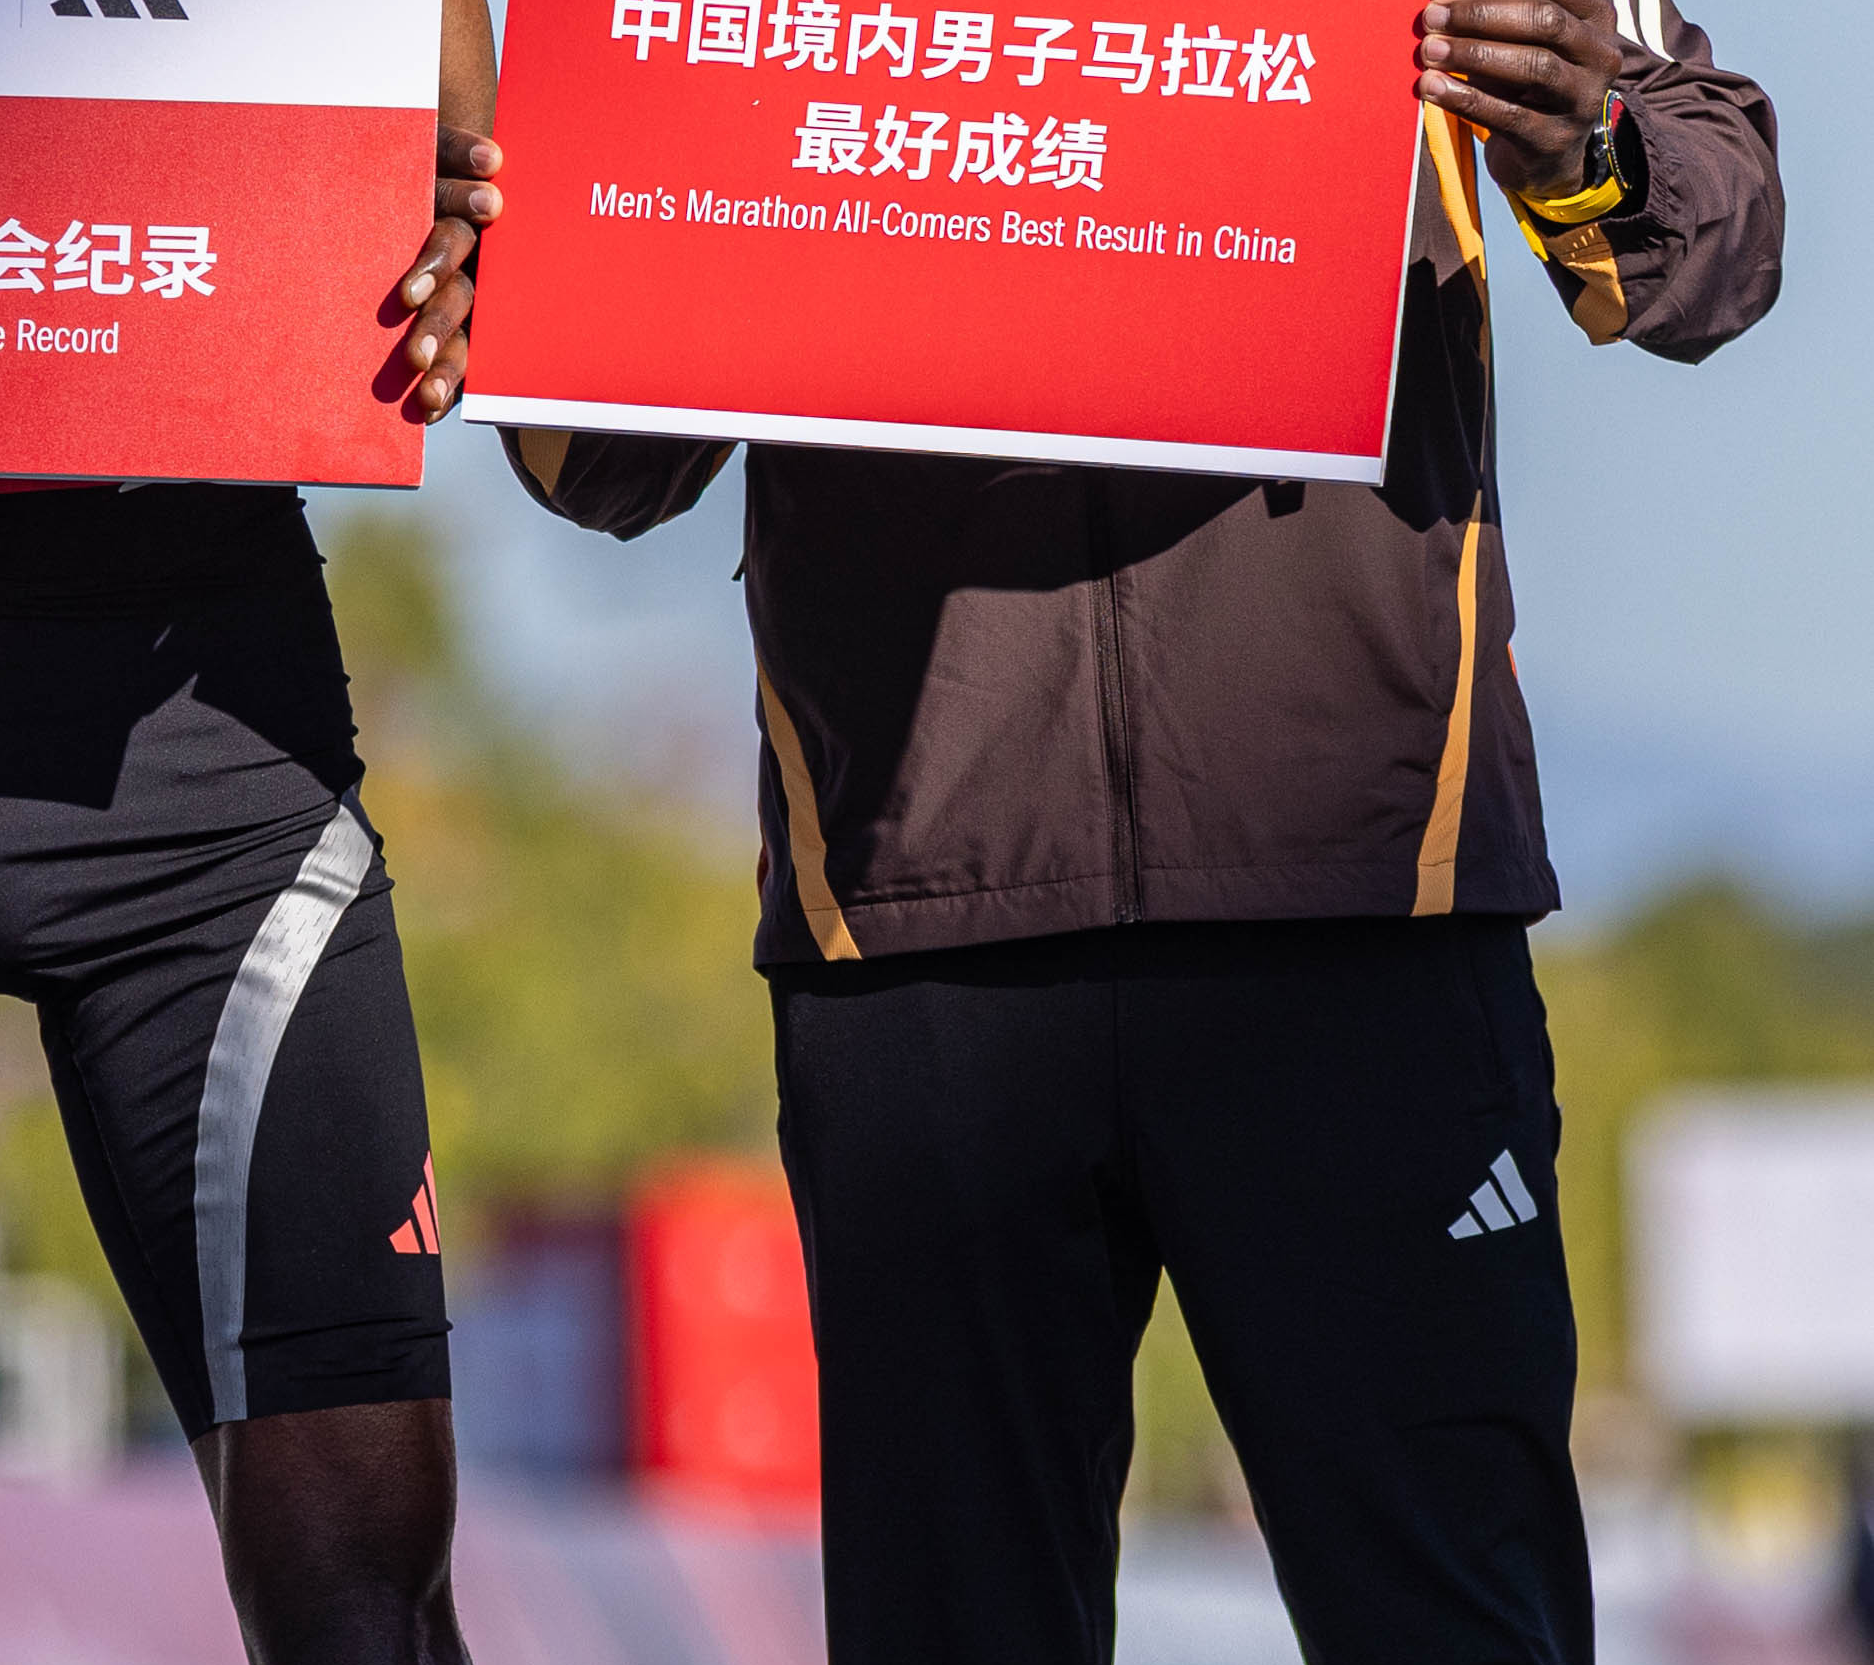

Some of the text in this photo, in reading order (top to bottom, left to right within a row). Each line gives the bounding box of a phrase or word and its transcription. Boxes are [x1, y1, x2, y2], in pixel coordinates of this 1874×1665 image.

[790, 100, 1109, 193] 最好成绩
[589, 182, 1297, 265] Men’s Marathon All-Comers Best Result in China
[16, 318, 120, 355] Record
